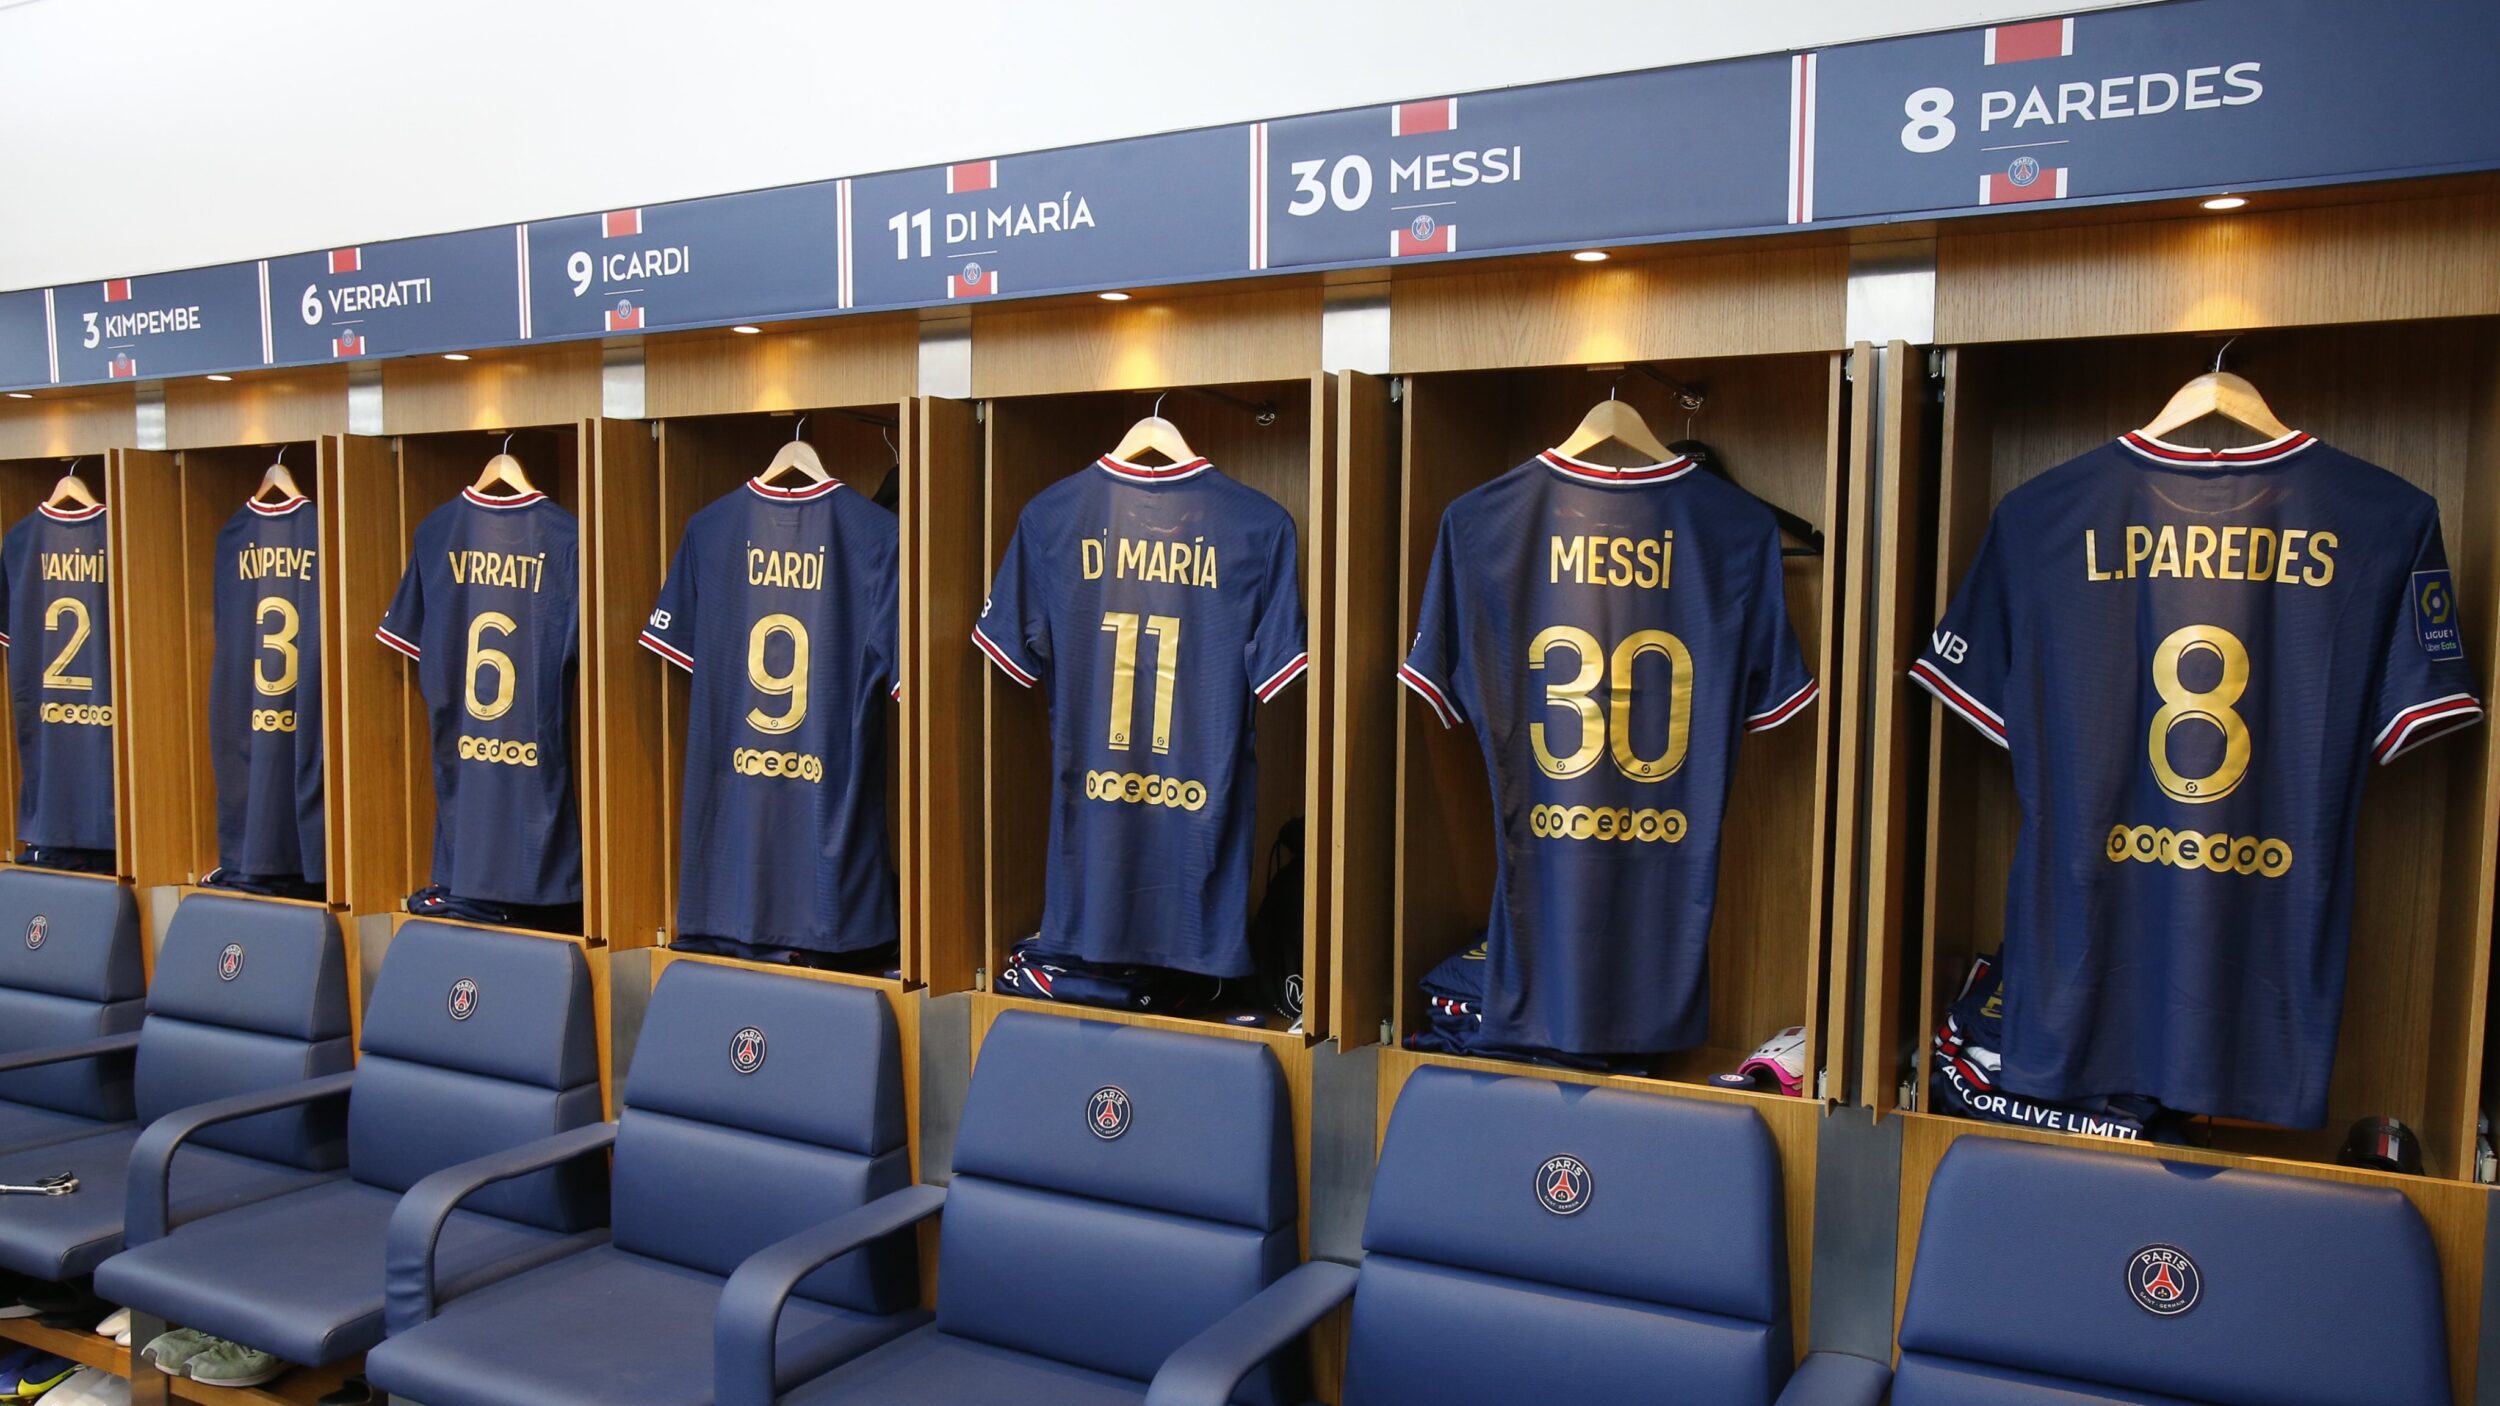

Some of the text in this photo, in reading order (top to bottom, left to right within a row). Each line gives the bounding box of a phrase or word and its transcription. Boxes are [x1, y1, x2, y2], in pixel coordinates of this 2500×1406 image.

[1900, 61, 2264, 153] 8 PAREDES
[1287, 145, 1521, 217] 30 MESSI
[888, 191, 1096, 261] 11 DI MARÍA
[567, 245, 690, 298] 9 ICARDI
[83, 305, 201, 350] 3 KIMPEMBE
[302, 277, 432, 326] 6 VERRATTI
[1116, 534, 1218, 589] MARÍA
[2086, 525, 2339, 588] L.PAREDES
[43, 596, 93, 690] 2
[254, 596, 299, 696] 3
[2425, 629, 2449, 640] LIGUE
[2440, 641, 2457, 651] Eats
[464, 611, 517, 721] 6
[746, 613, 809, 735] 9
[1100, 611, 1180, 755] 11
[1529, 625, 1694, 783] 30
[2149, 624, 2251, 804] 8
[1086, 770, 1207, 811] oredoo
[1530, 804, 1687, 844] ooredoo
[2106, 824, 2293, 878] ooredoo
[740, 1031, 761, 1044] PARIS
[1096, 1091, 1125, 1105] PARIS
[1942, 1065, 2007, 1116] ACCOR
[2011, 1101, 2063, 1130] LIVE
[1547, 1160, 1583, 1176] PARIS
[2141, 1251, 2188, 1271] PARIS
